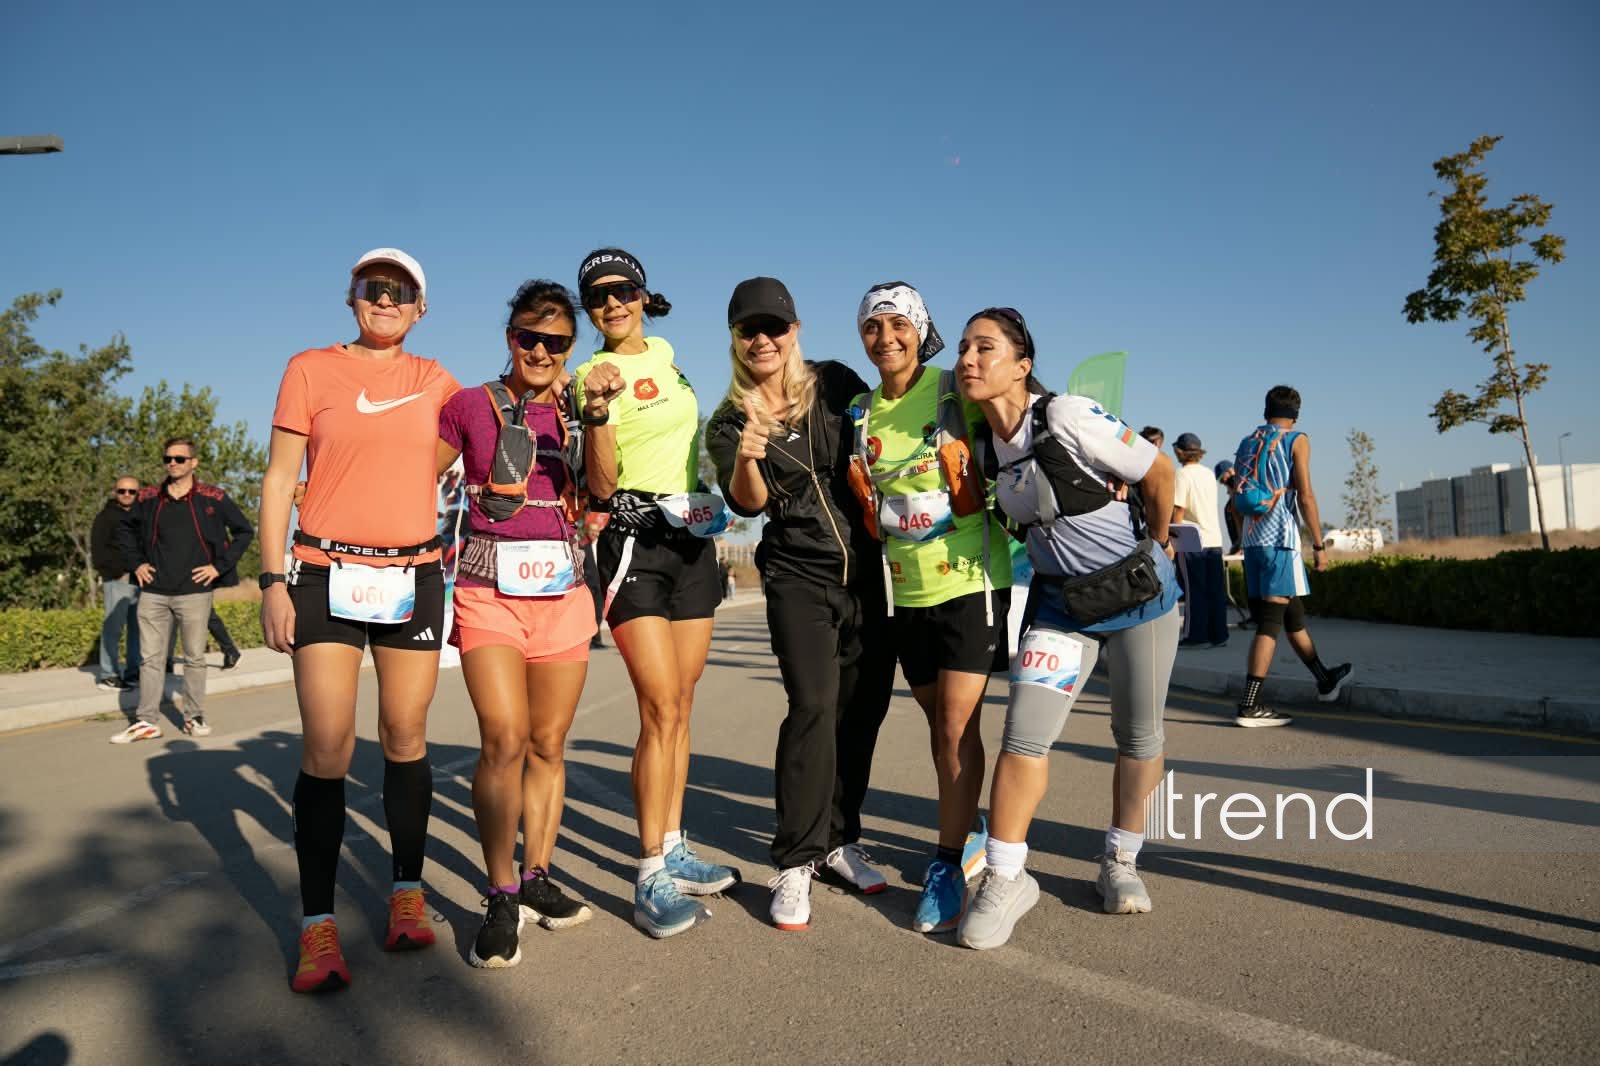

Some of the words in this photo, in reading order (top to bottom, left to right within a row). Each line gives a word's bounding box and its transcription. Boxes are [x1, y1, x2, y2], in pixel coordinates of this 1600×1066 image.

[682, 505, 713, 525] 065
[899, 512, 932, 531] 046
[335, 543, 399, 556] WRELS
[518, 561, 555, 579] 002
[1022, 650, 1059, 671] 070
